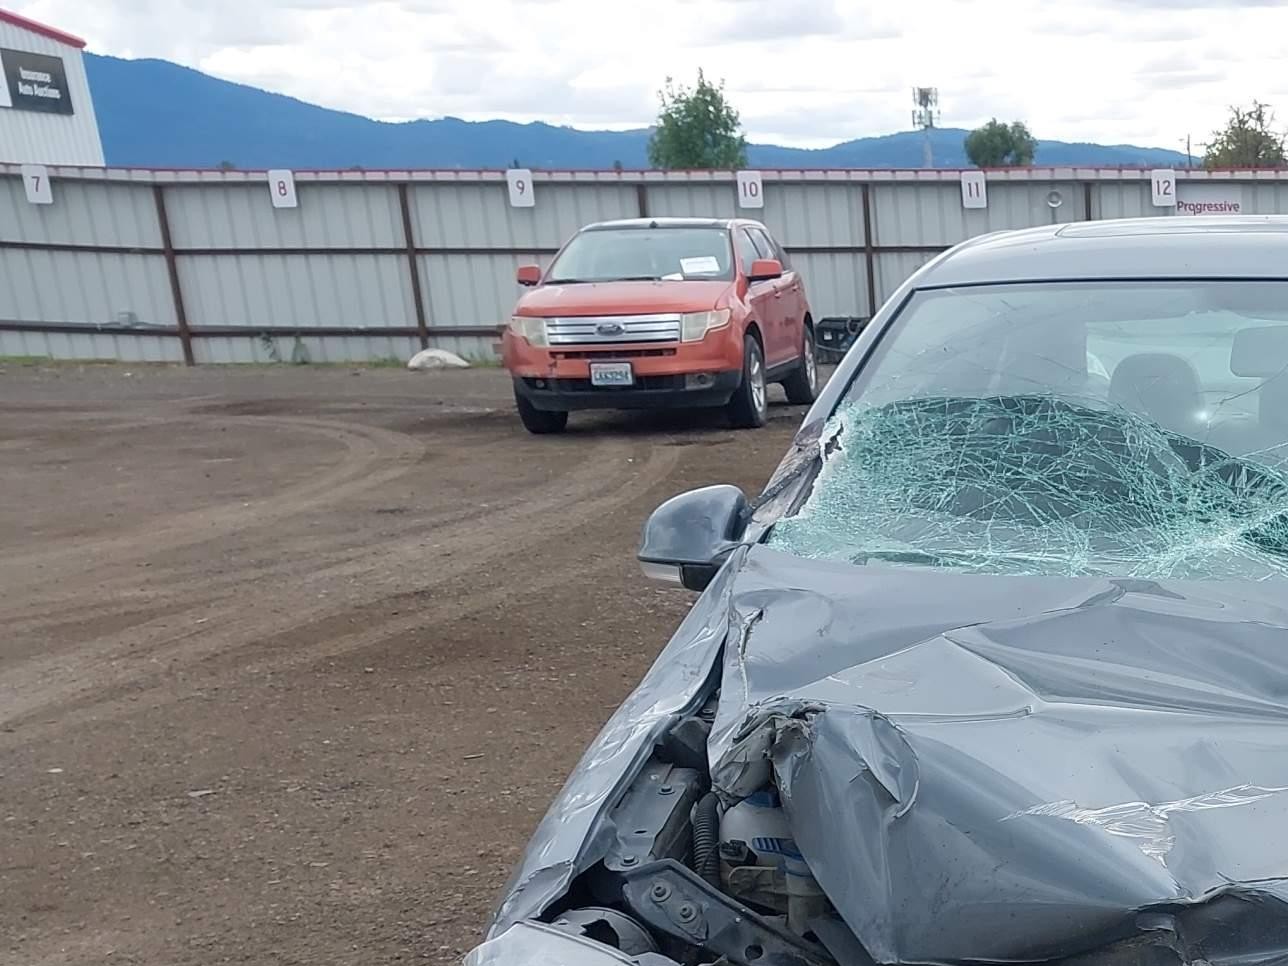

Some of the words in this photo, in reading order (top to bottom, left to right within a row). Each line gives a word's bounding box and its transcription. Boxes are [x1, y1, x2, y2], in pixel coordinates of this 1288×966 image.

[31, 176, 41, 193] 7
[277, 180, 288, 197] 8
[515, 180, 525, 196] 9
[742, 181, 759, 198] 10
[967, 182, 980, 198] 11
[1156, 180, 1172, 196] 12
